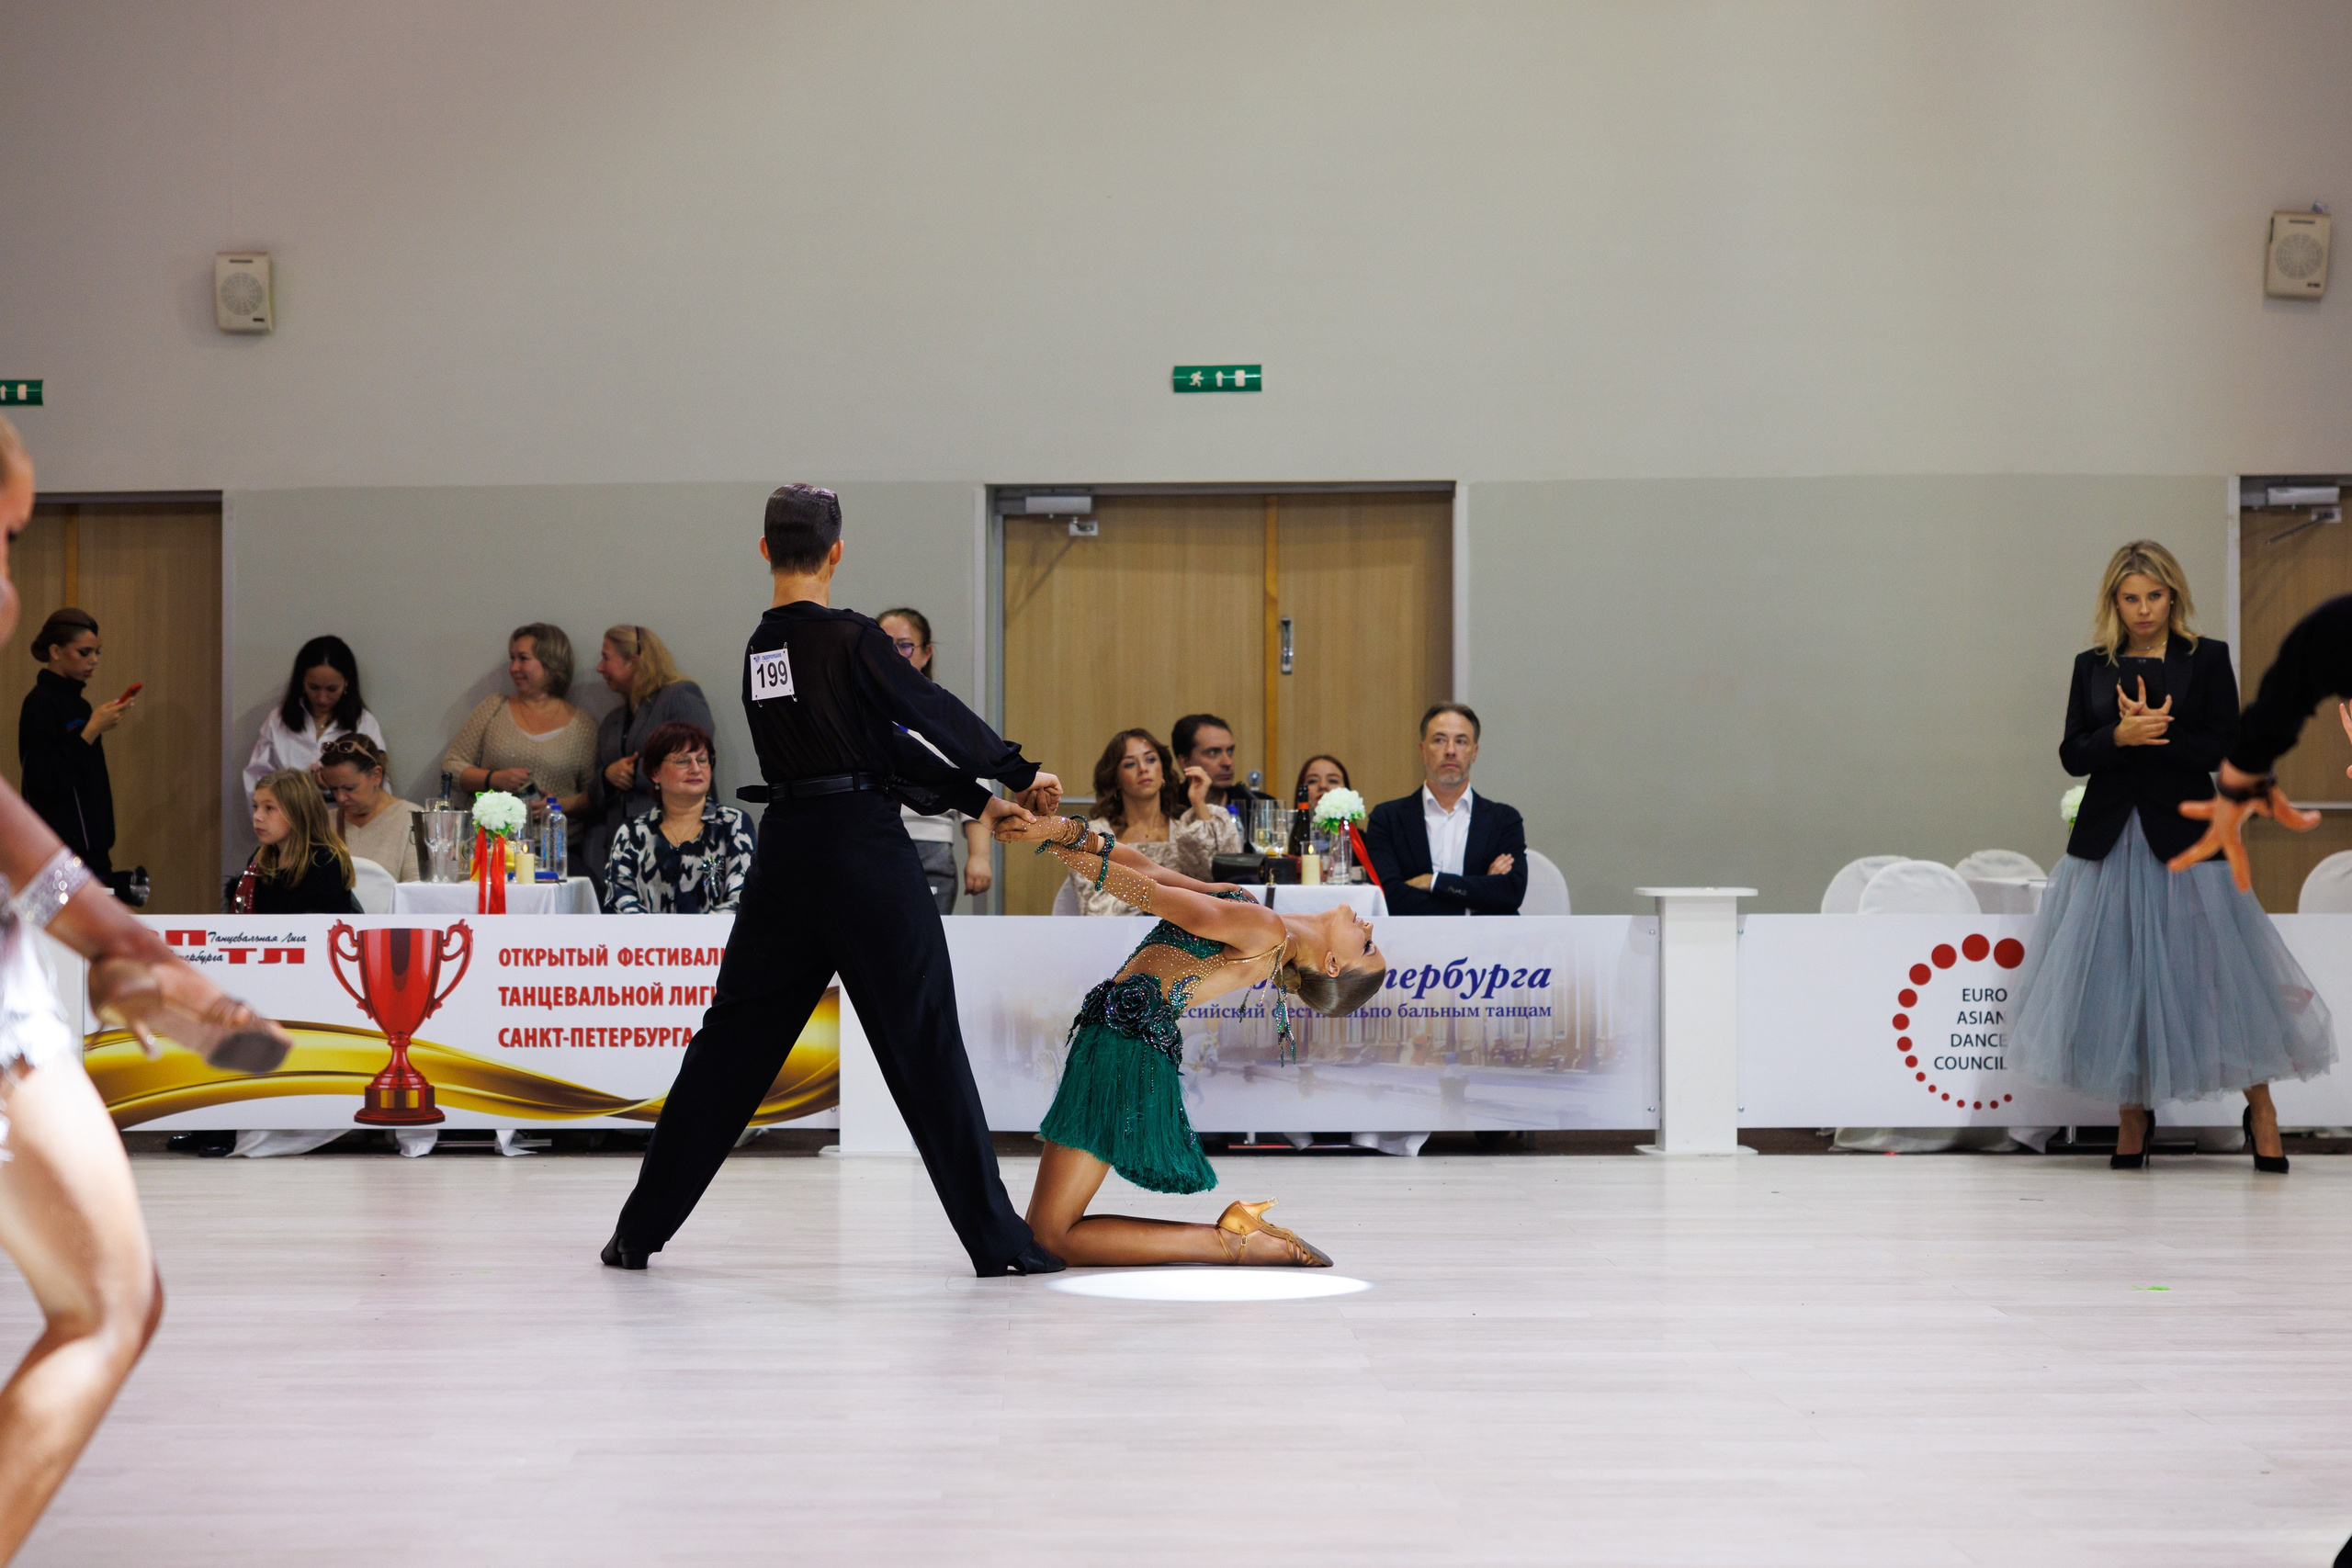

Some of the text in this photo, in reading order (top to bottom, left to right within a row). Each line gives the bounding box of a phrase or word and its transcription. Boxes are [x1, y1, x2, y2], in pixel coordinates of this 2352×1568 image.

[756, 660, 788, 688] 199
[208, 931, 307, 944] Танцевальная Лига
[498, 943, 608, 967] ОТКРЫТЫЙ
[498, 982, 663, 1010] ТАНЦЕВАЛЬНОЙ
[1962, 988, 2007, 1002] EURO
[1181, 1004, 1265, 1019] сийский
[1397, 1003, 1479, 1019] бальным
[1486, 1006, 1552, 1020] танцам
[1956, 1010, 2007, 1025] ASIAN
[497, 1027, 694, 1048] САНКТ-ПЕТЕРБУРГА
[1951, 1033, 2008, 1047] DANCE
[1933, 1055, 2008, 1071] COUNCIL
